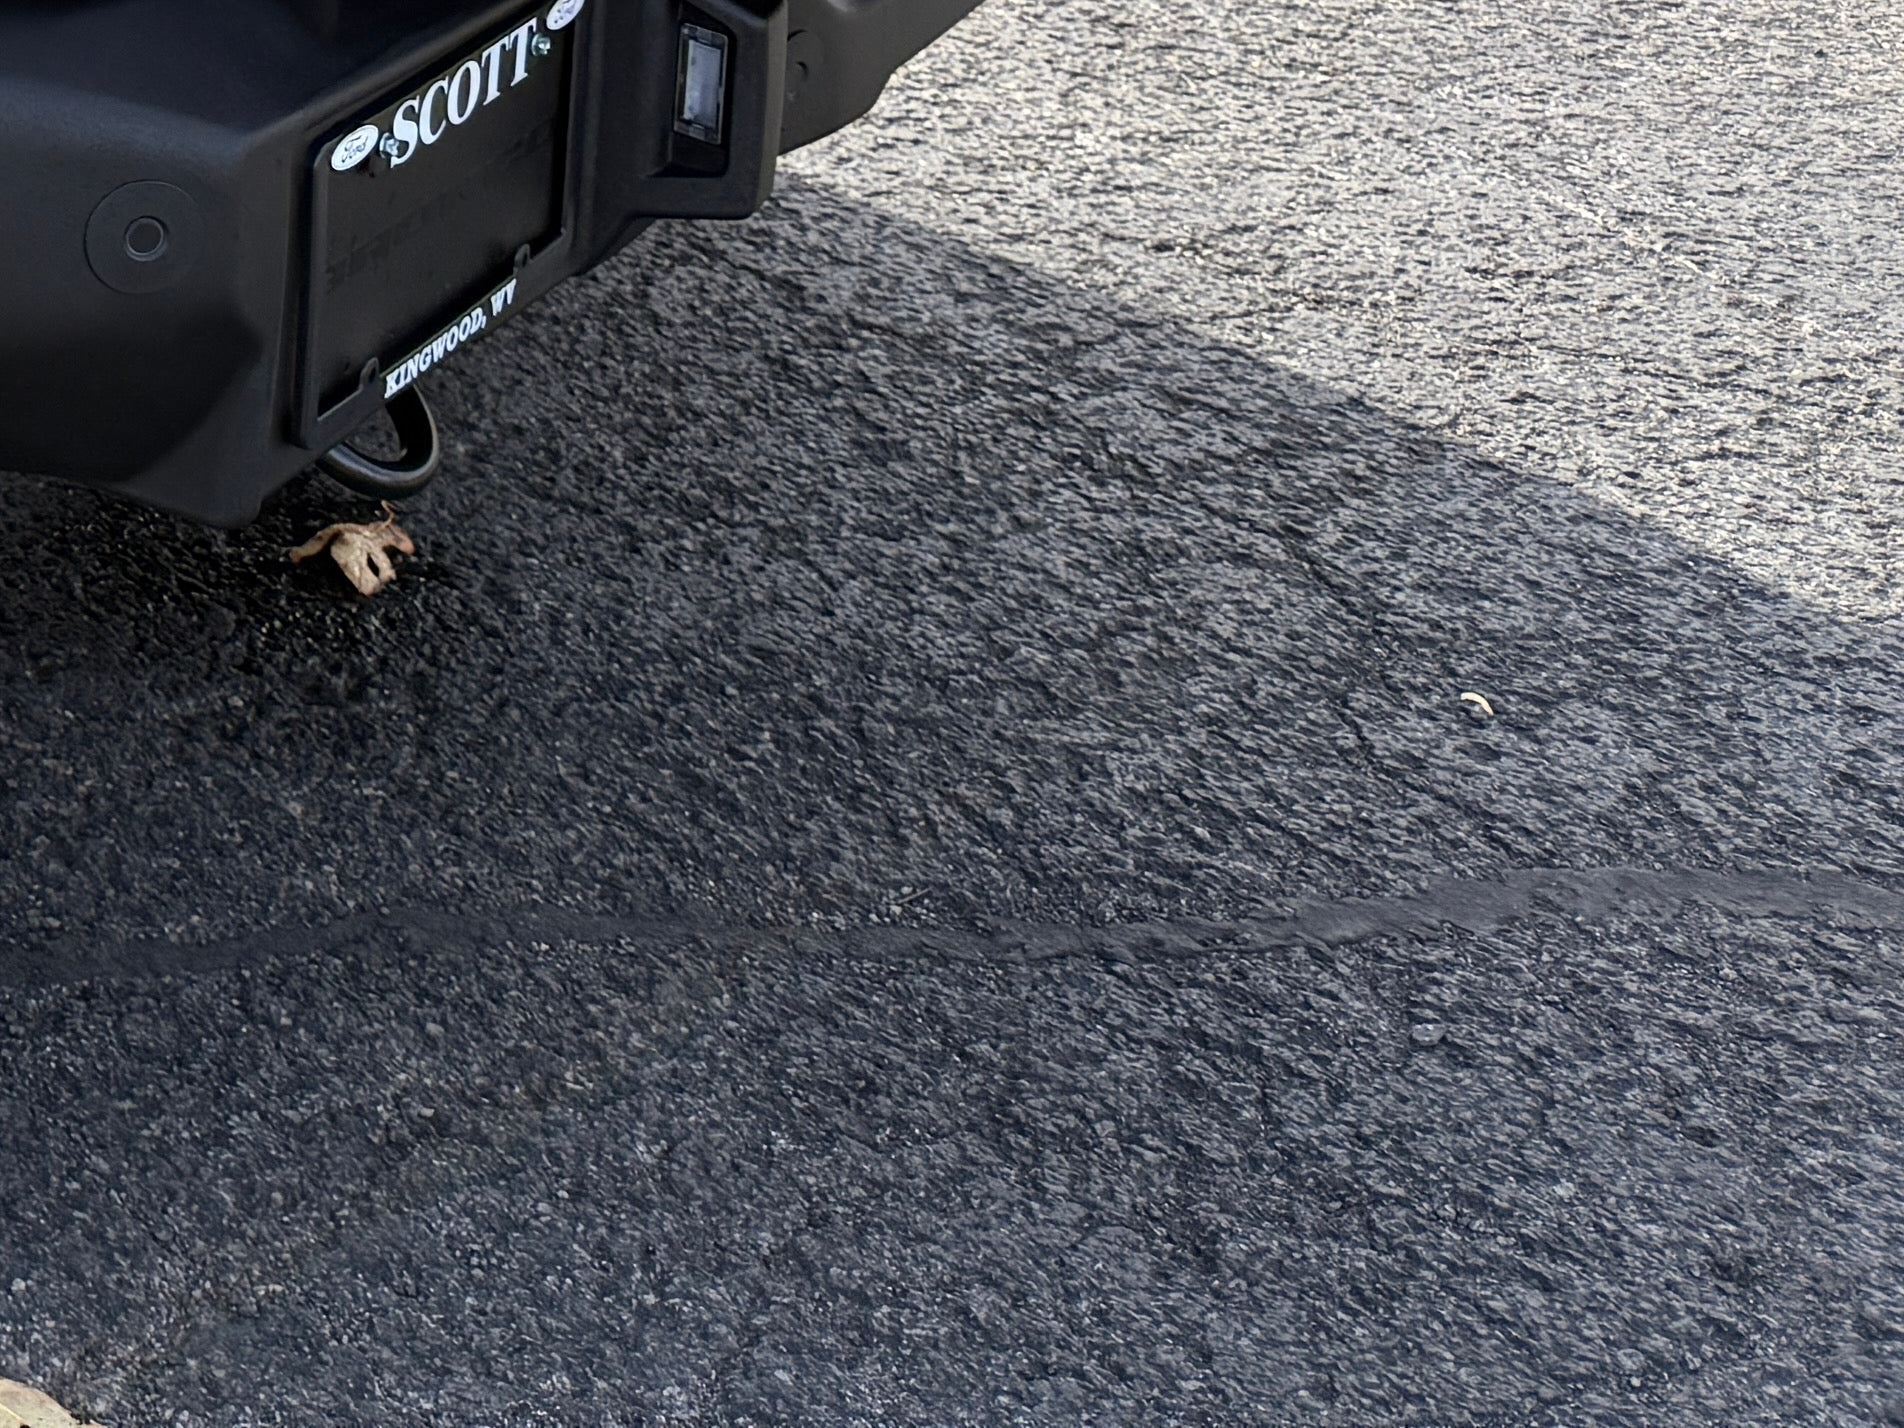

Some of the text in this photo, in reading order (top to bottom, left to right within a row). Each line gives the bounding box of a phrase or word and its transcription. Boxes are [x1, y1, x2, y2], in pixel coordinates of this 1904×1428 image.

[388, 16, 538, 170] SCOTT
[383, 277, 518, 400] KINGWOOD, WV
